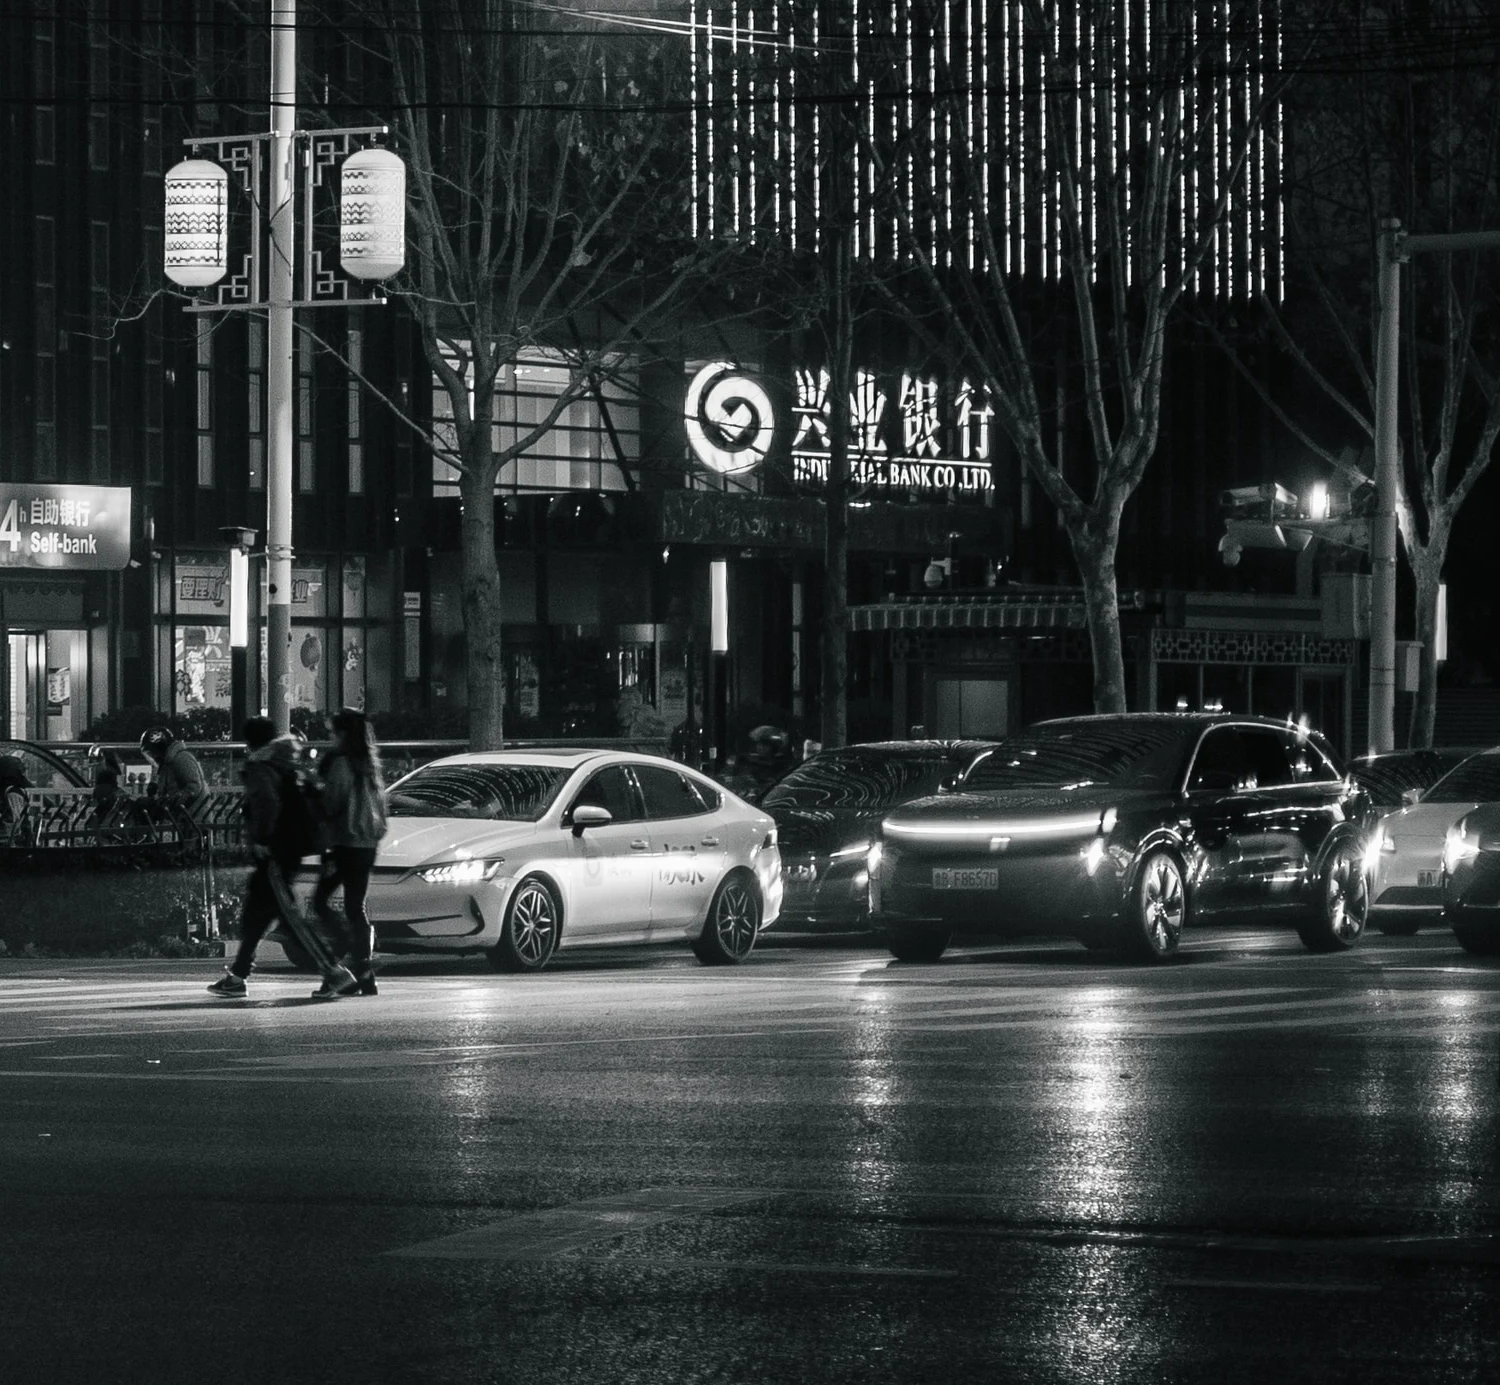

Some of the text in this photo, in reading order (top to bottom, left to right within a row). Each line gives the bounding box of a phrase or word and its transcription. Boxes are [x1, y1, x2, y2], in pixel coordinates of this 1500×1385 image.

[792, 369, 995, 459] 兴业银行
[890, 464, 932, 487] BANK
[30, 498, 91, 526] 自助银行
[30, 531, 97, 554] Self-bank
